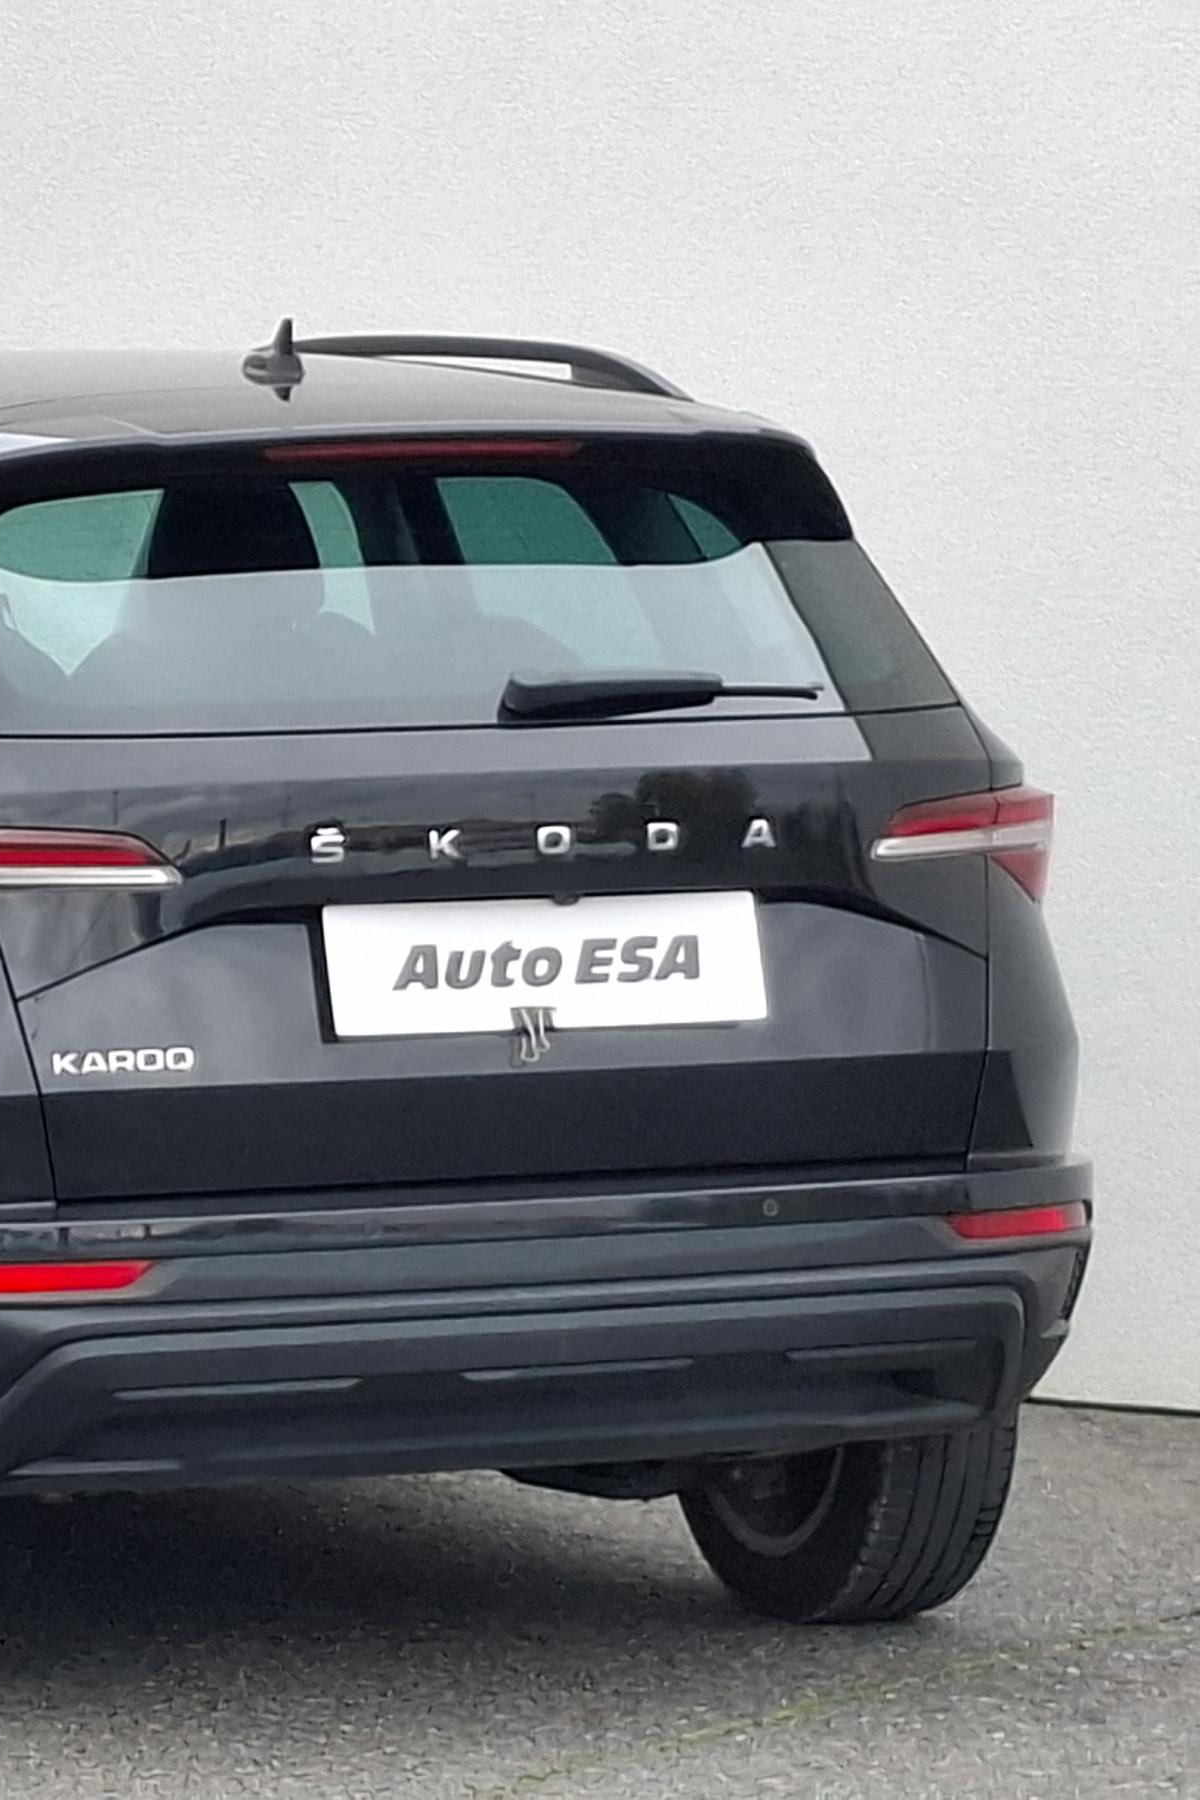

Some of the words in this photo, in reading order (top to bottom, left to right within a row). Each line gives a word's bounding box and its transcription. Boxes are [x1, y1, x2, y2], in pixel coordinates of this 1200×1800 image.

[310, 817, 776, 864] ŠKODA
[393, 941, 563, 991] Auto
[574, 935, 701, 985] ESA
[52, 1047, 195, 1076] KAROQ
